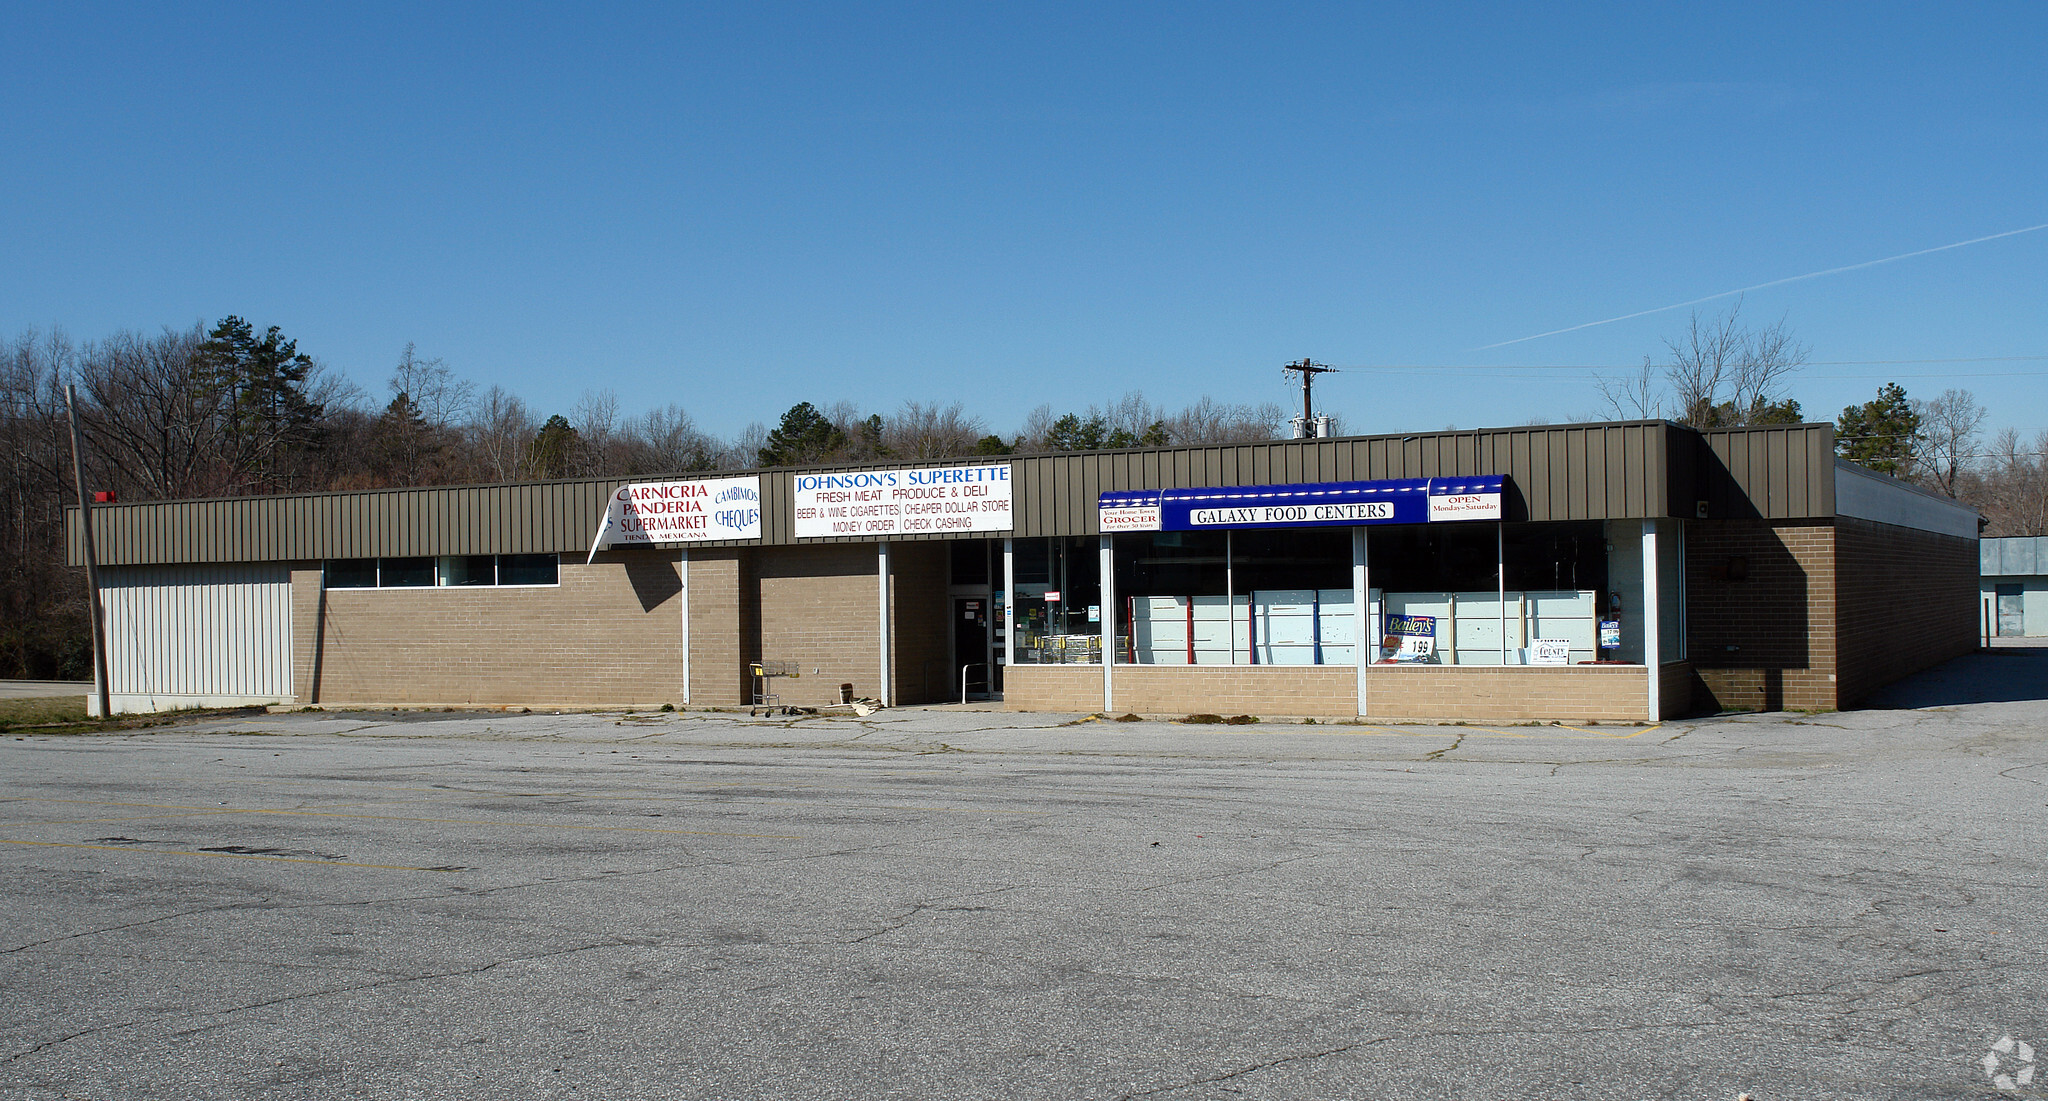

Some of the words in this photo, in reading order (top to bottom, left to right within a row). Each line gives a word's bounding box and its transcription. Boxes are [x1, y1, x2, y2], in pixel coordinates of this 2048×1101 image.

[797, 473, 897, 492] JOHNSON'S
[908, 467, 1009, 485] SUPERETTE
[616, 484, 708, 501] CARNICRIA
[816, 491, 851, 503] FRESH
[854, 490, 883, 502] MEAT
[892, 487, 946, 499] PRODUCE
[951, 486, 958, 497] &
[963, 485, 988, 497] DELI
[1448, 495, 1481, 503] OPEN
[623, 500, 702, 515] PANDERIA
[797, 508, 817, 519] BEER
[819, 508, 824, 518] &
[828, 506, 847, 518] WINE
[850, 504, 900, 517] CIGARETTES
[904, 502, 942, 514] CHEAPER
[945, 501, 978, 513] DOLLAR
[981, 500, 1009, 512] STORE
[1197, 508, 1257, 523] GALAXY
[1265, 506, 1307, 521] FOOD
[1314, 504, 1386, 519] CENTERS
[620, 515, 708, 532] SUPERMARKET
[715, 508, 759, 531] CHEQUES
[832, 521, 862, 532] MONEY
[866, 519, 894, 531] ORDER
[903, 518, 932, 530] CHECK
[935, 516, 972, 529] CASHING
[1103, 516, 1156, 524] GROCER
[624, 533, 654, 541] TIENDA
[659, 532, 707, 540] MEXICANA
